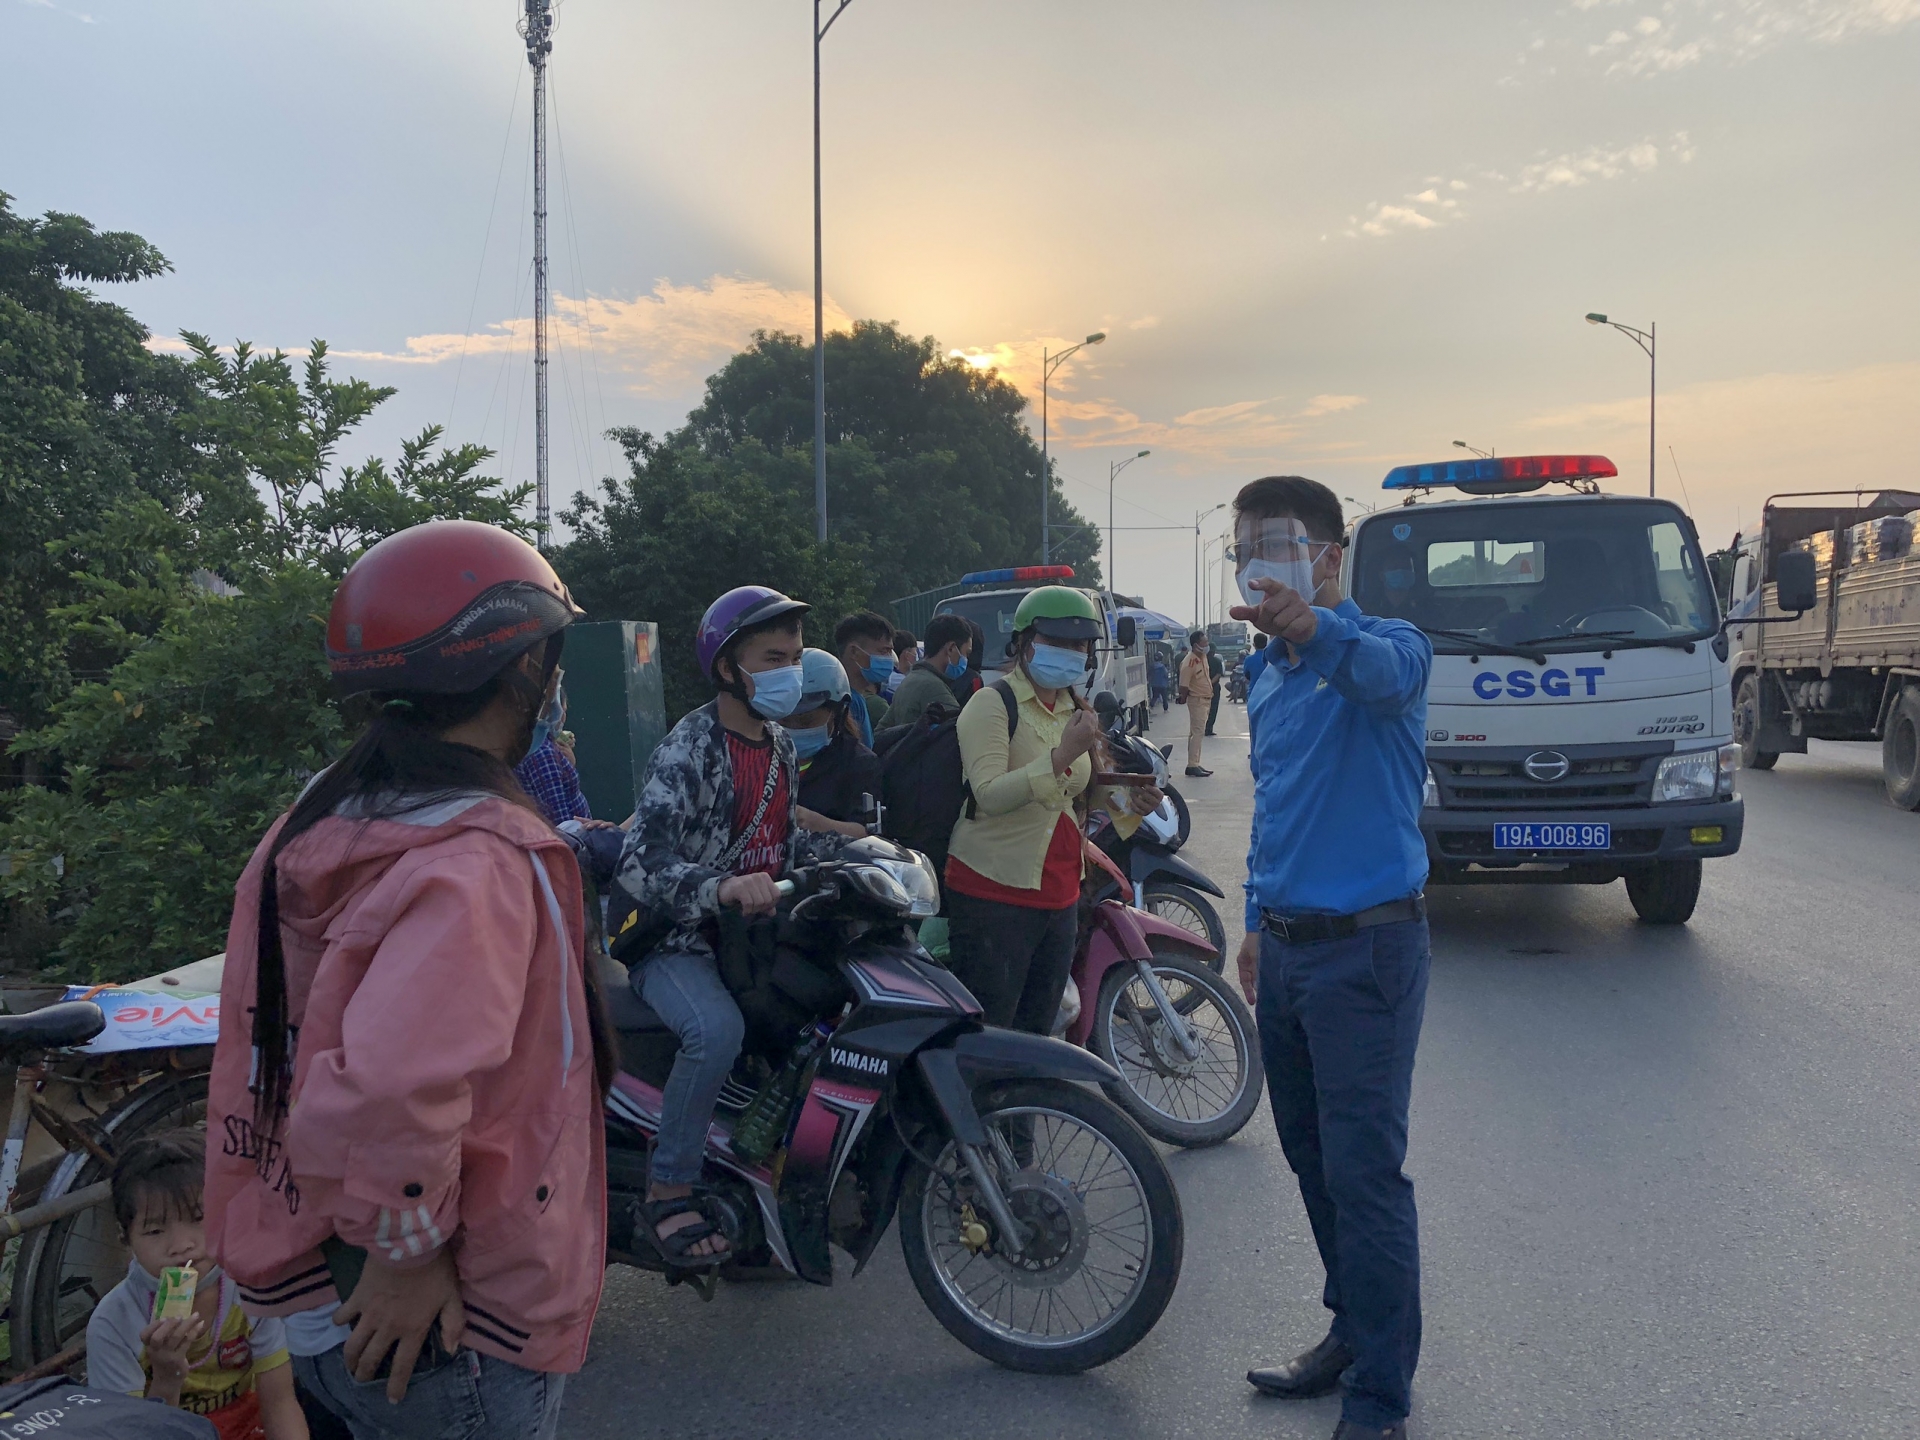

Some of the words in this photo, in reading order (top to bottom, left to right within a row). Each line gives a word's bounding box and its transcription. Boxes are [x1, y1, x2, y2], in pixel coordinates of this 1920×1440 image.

[450, 598, 529, 636] HONDA-YAMAHA
[1473, 667, 1605, 700] CSGT
[1454, 734, 1487, 742] 300
[1637, 723, 1705, 735] DUTRO
[1500, 826, 1606, 846] 19A-008.96
[831, 1047, 888, 1075] YAMAHA
